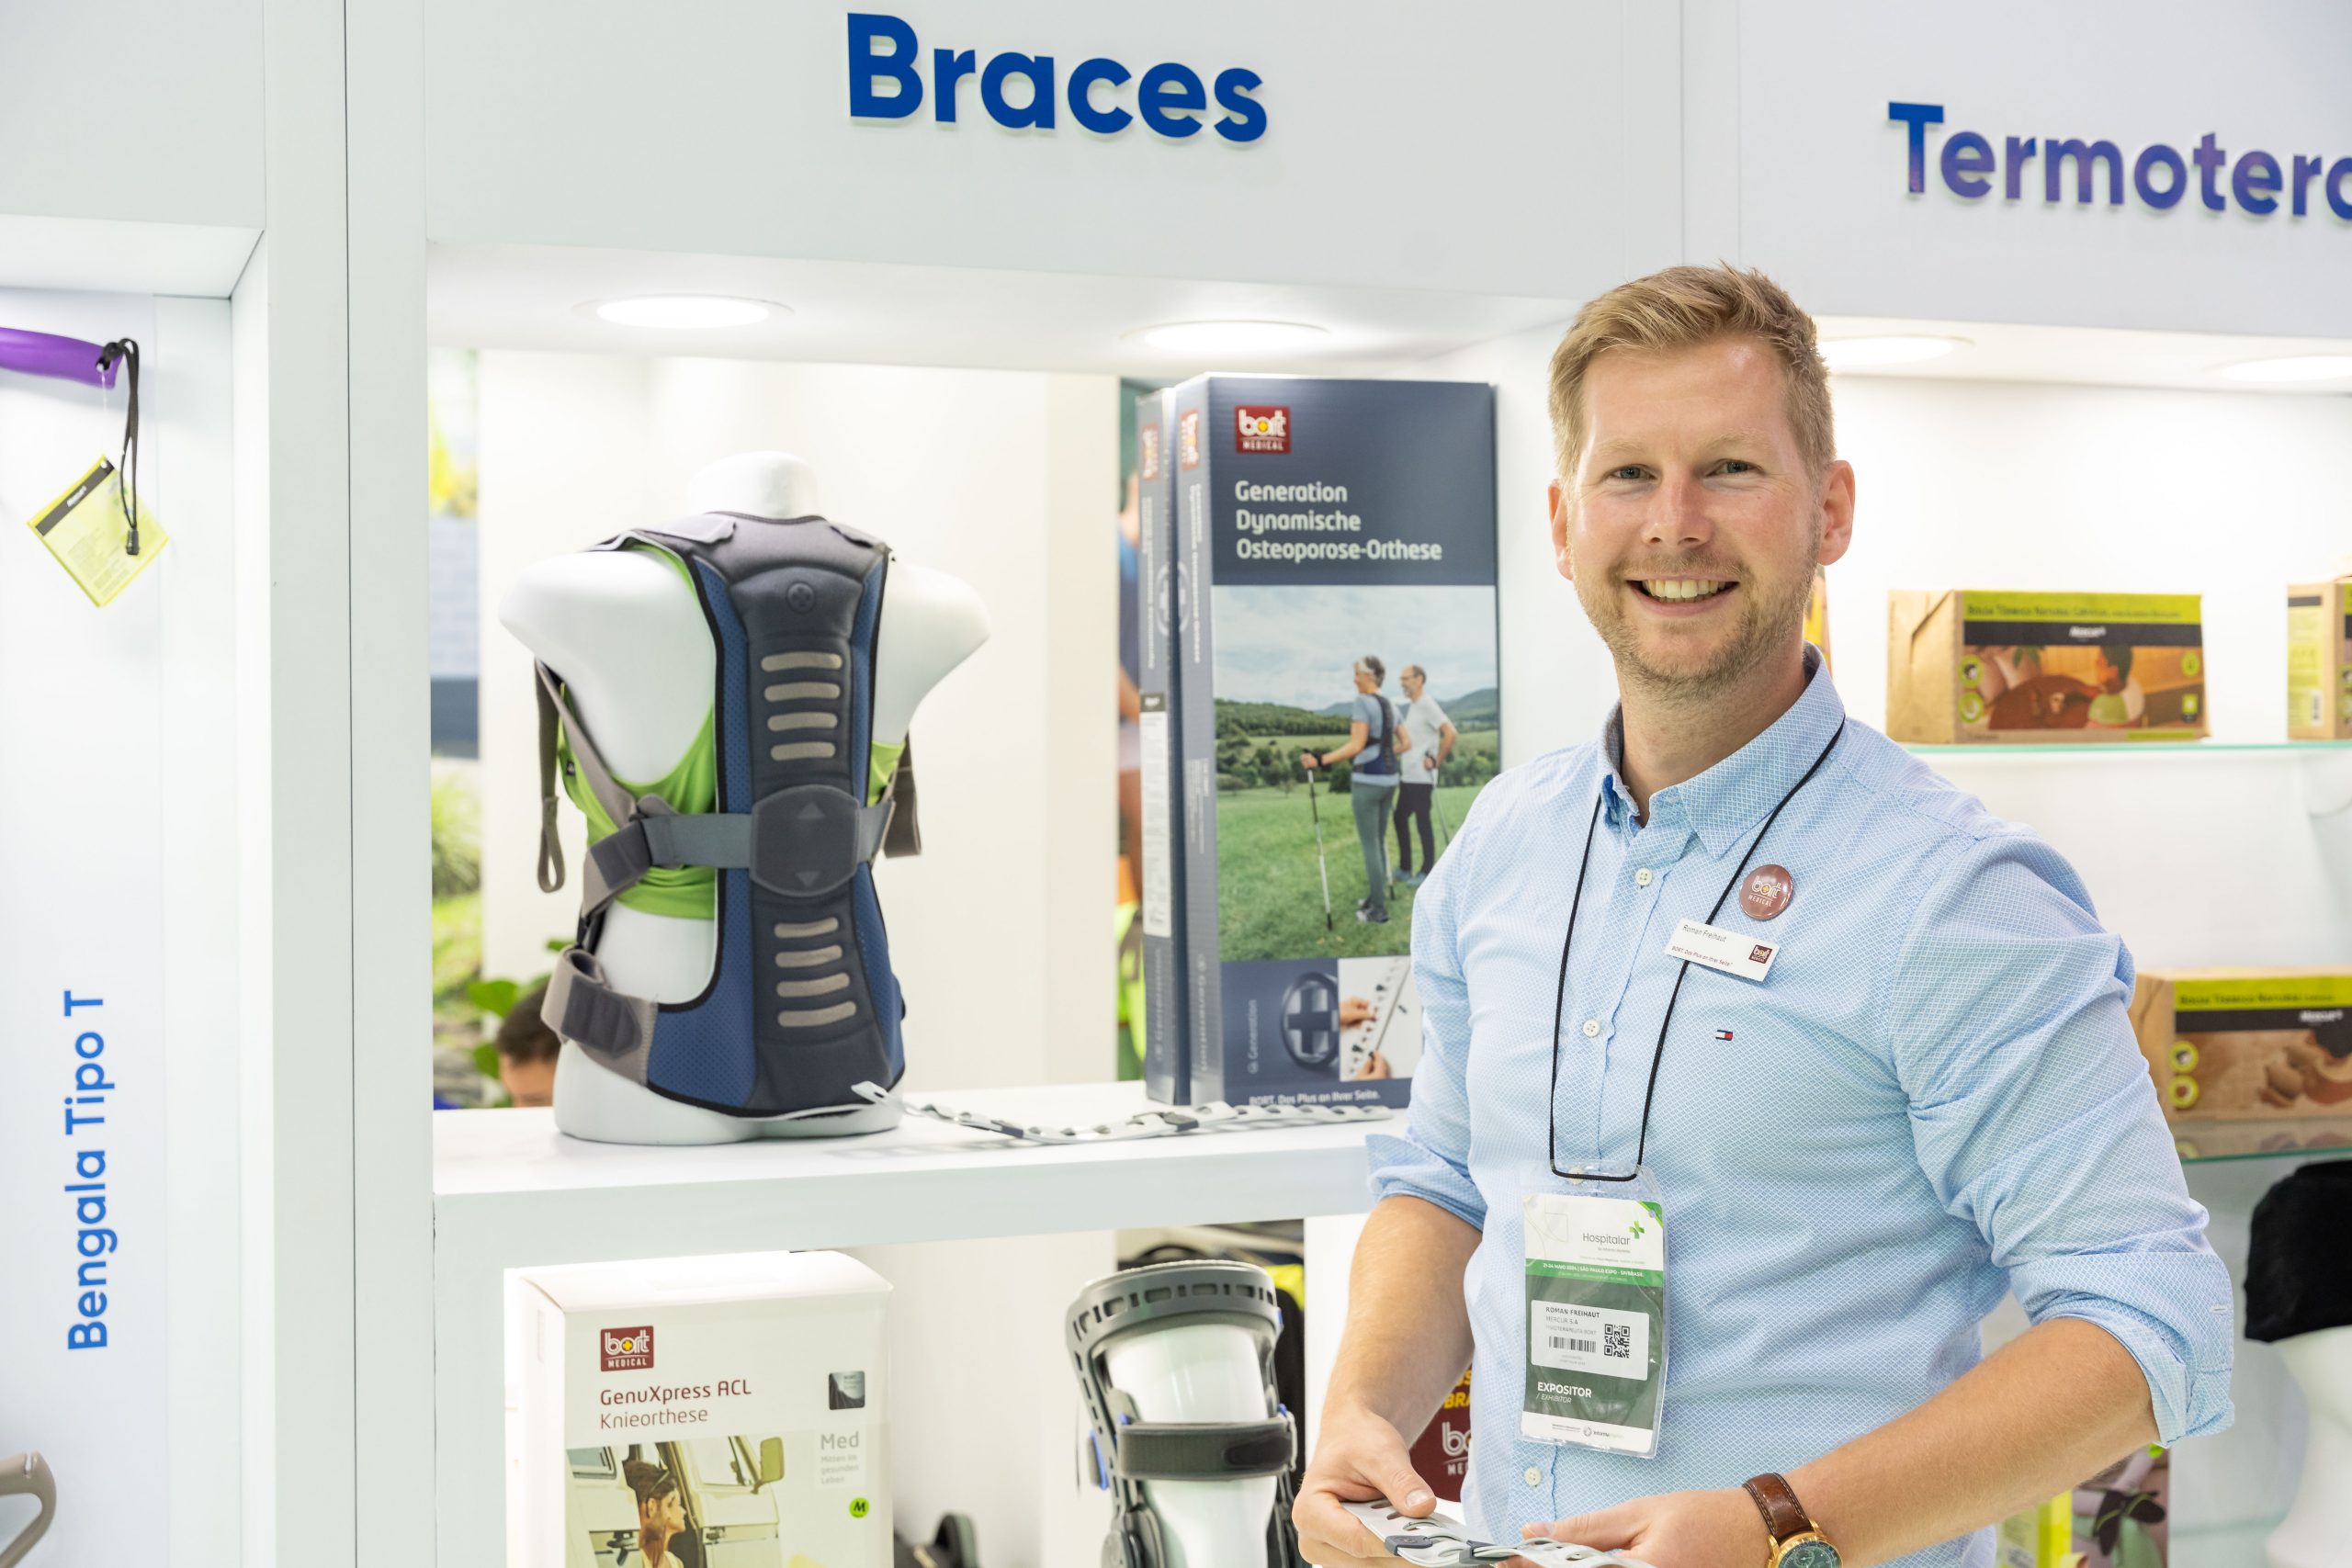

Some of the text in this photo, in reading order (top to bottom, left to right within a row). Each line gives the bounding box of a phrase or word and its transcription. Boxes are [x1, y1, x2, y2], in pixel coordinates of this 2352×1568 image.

[848, 13, 1268, 141] Braces
[1238, 409, 1286, 436] bort
[1243, 440, 1284, 450] MEDICAL
[1236, 479, 1348, 502] Generation
[1236, 508, 1362, 535] Dynamische
[1237, 537, 1443, 564] Osteoporose-Orthese
[1752, 875, 1781, 899] bort
[1748, 894, 1772, 907] MEDICAL
[1683, 924, 1726, 942] Roman Freihaut
[1754, 947, 1770, 960] bort
[1296, 1092, 1317, 1103] Plus
[63, 990, 118, 1349] Bengala Tipo T
[1582, 1232, 1631, 1246] Hospitalar
[1545, 1306, 1600, 1318] ROMAN FREIHAUT
[1546, 1315, 1568, 1324] MERCUR
[605, 1329, 650, 1356] bort
[607, 1357, 648, 1369] MEDICAL
[600, 1379, 752, 1405] GenuXpress ACL
[1537, 1381, 1592, 1398] EXPOSITOR
[1541, 1393, 1572, 1404] EXHIBITOR
[600, 1408, 708, 1429] Knieorthese
[820, 1430, 859, 1450] Med
[854, 1501, 865, 1512] M
